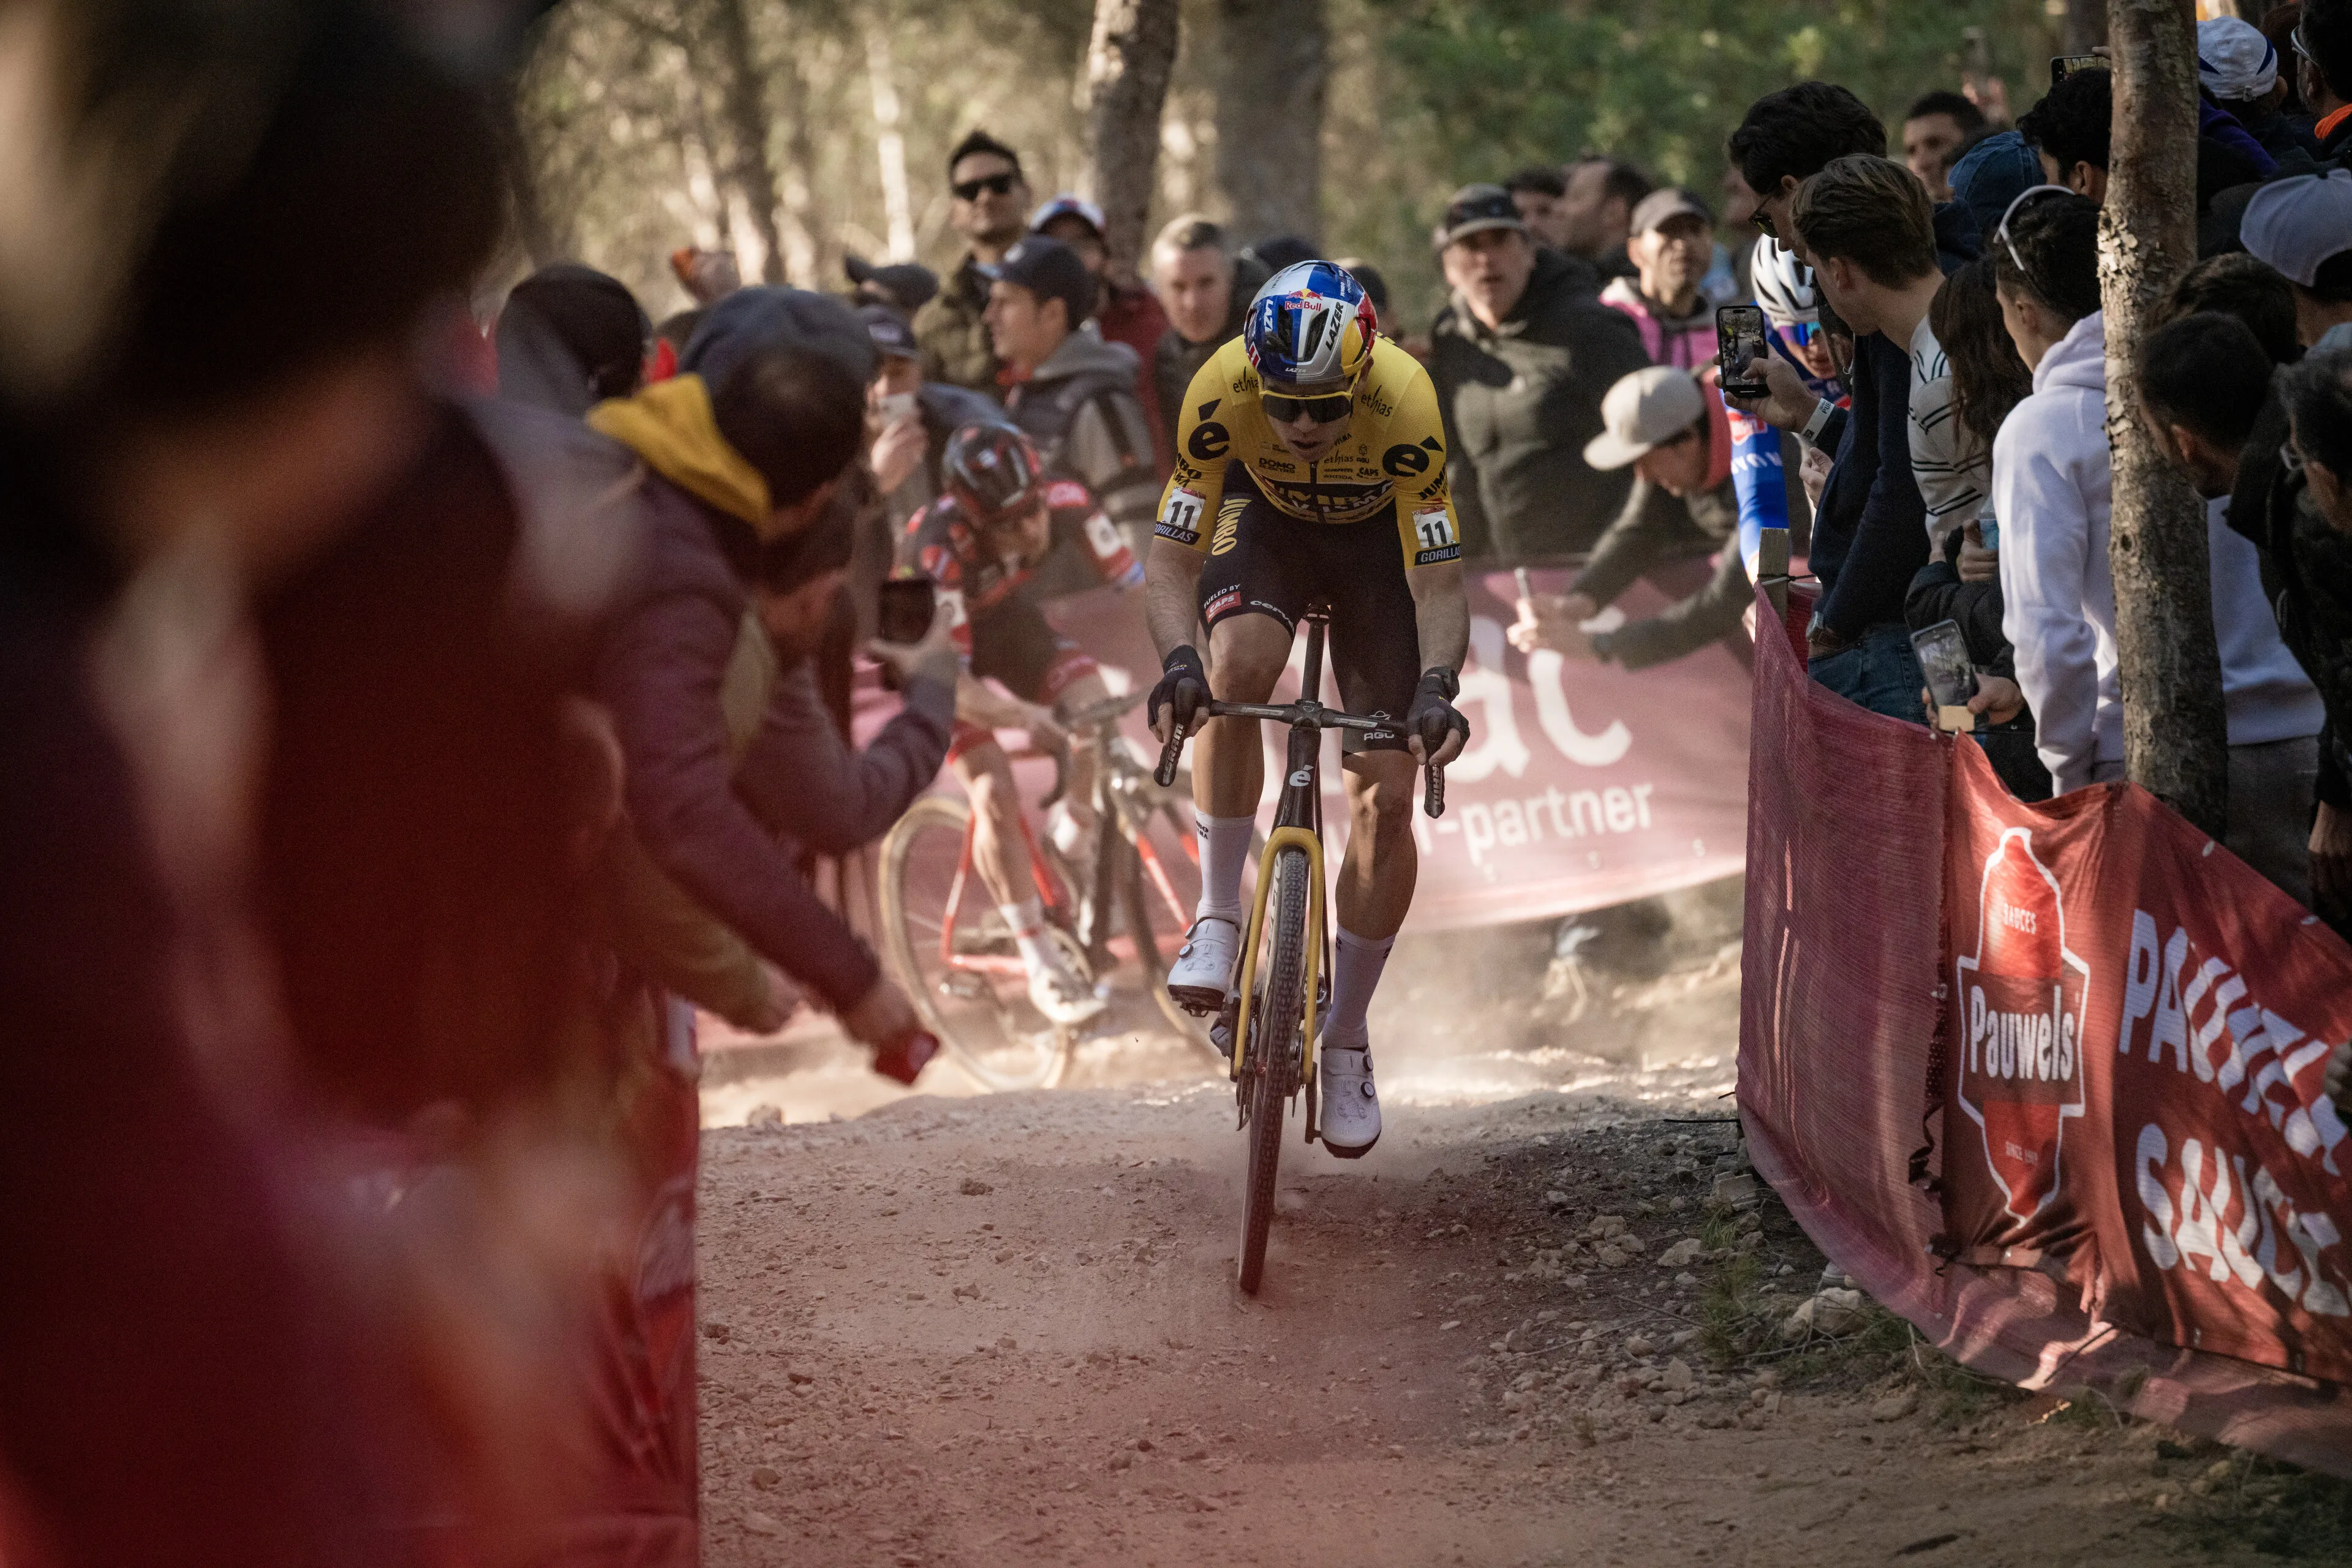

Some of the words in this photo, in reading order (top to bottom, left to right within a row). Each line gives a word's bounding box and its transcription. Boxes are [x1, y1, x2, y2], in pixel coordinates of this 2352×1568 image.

[1284, 301, 1302, 311] Red
[1303, 301, 1321, 311] Bull
[1325, 301, 1344, 351] LAZER
[1233, 366, 1259, 394] ethia
[1360, 385, 1393, 417] ethias
[1259, 458, 1296, 470] DOMO
[1324, 449, 1354, 465] ethias
[1170, 501, 1195, 530] 11
[1212, 499, 1253, 556] JUMBO
[1422, 521, 1448, 547] 11
[1204, 589, 1227, 609] FUELED
[1209, 595, 1234, 613] CAPS
[1164, 723, 1184, 772] SRAM
[1363, 732, 1395, 741] AGU
[2003, 902, 2037, 935] SAUCES
[1970, 984, 2075, 1082] Pauwels
